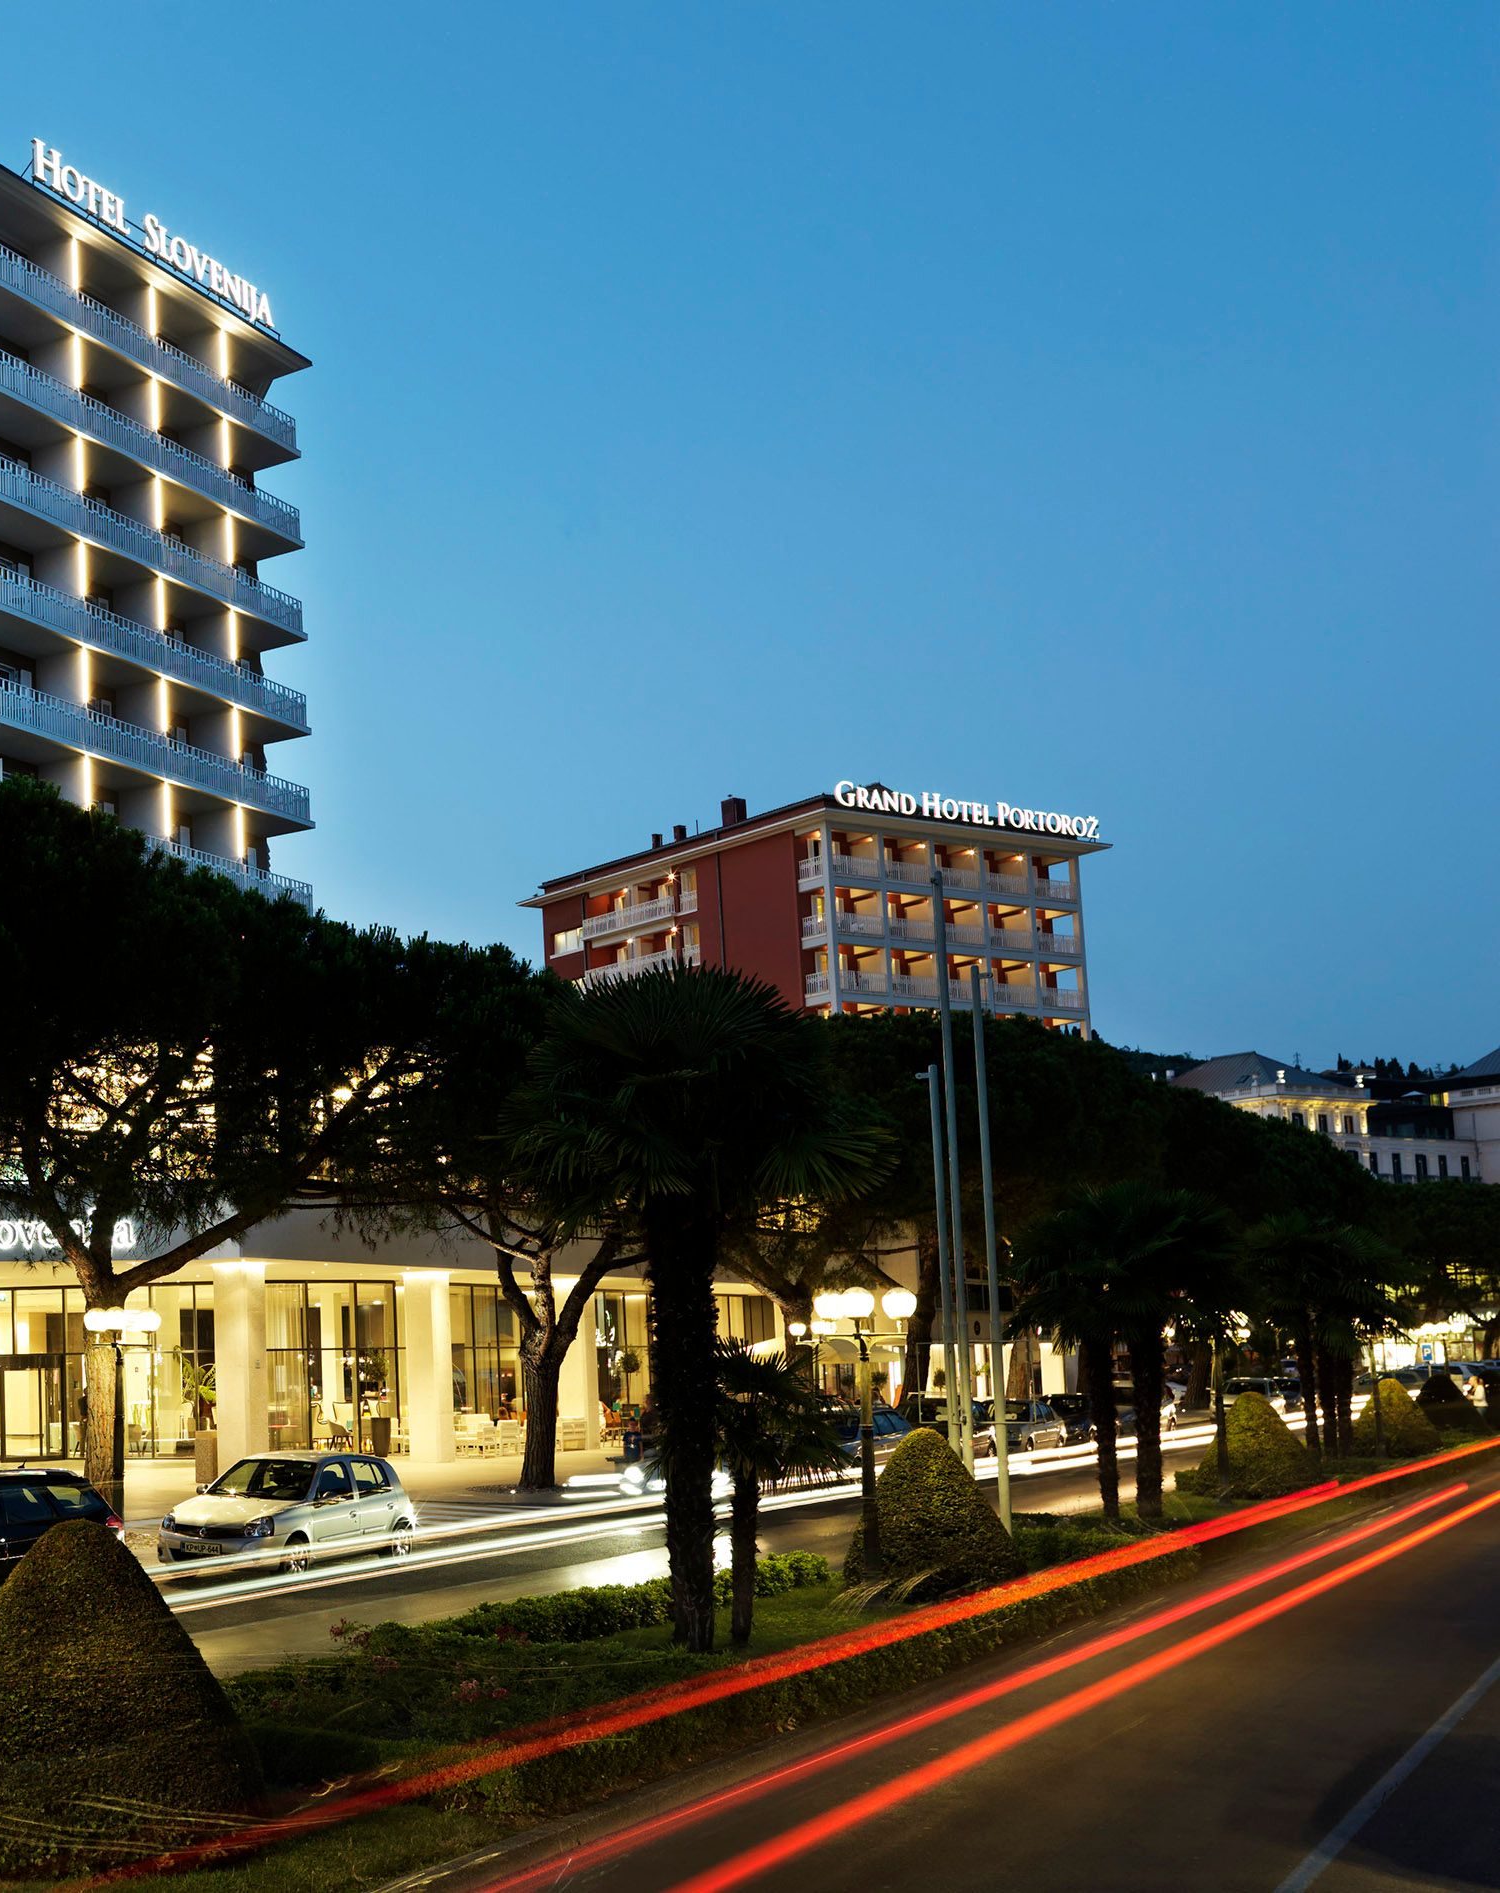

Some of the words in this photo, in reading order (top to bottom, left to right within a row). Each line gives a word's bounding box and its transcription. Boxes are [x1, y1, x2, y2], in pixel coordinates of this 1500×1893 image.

[31, 138, 131, 235] HOTEL
[143, 214, 275, 328] SLOVENIJA
[834, 780, 917, 815] GRAND
[921, 791, 994, 826] HOTEL
[996, 801, 1100, 839] PORTOROŽ
